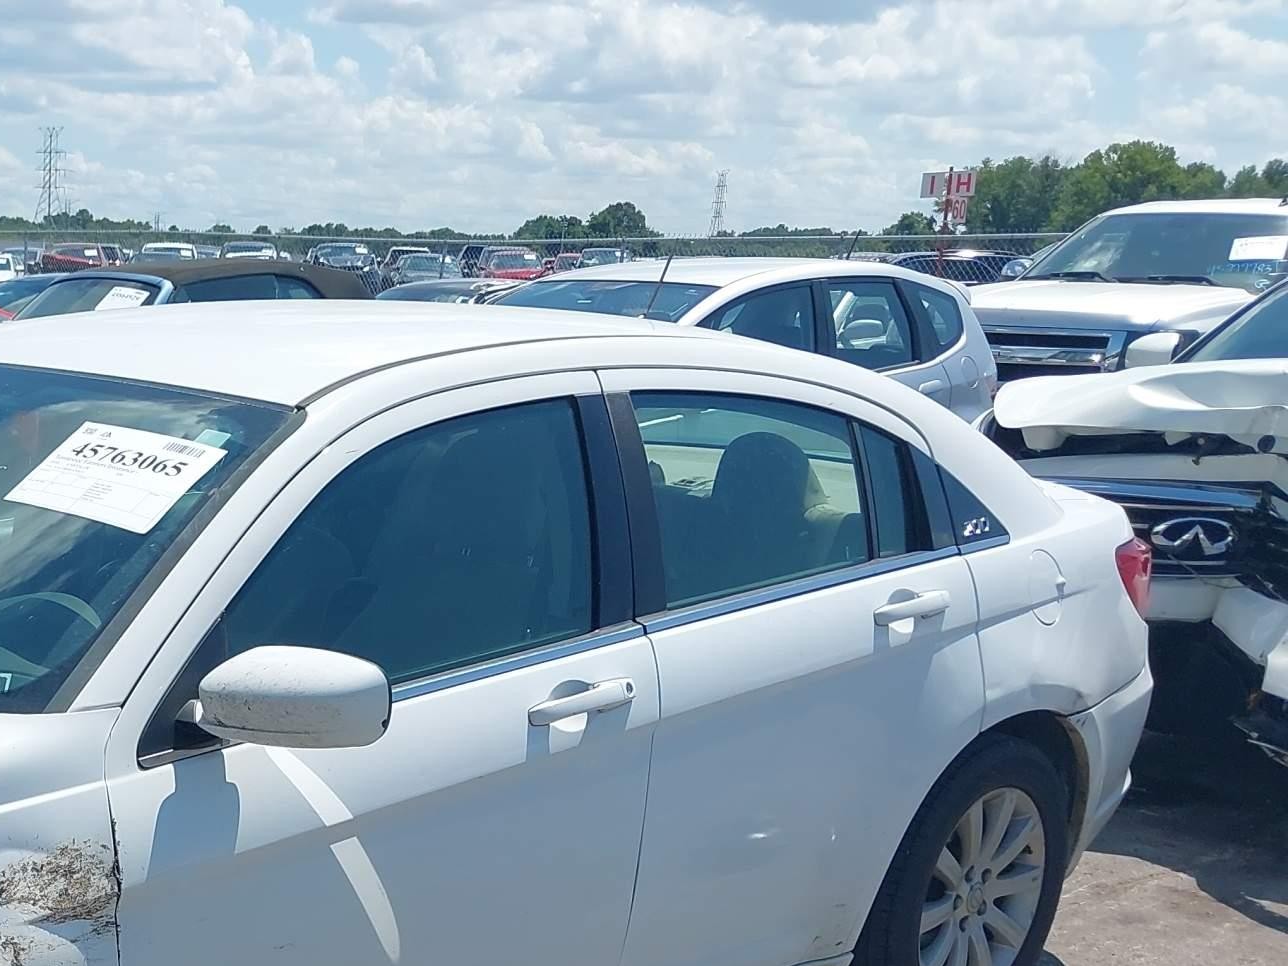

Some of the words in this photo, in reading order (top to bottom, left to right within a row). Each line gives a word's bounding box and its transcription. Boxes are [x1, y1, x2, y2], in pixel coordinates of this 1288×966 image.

[955, 173, 972, 194] H
[952, 199, 967, 220] 60
[72, 442, 189, 477] 45763065
